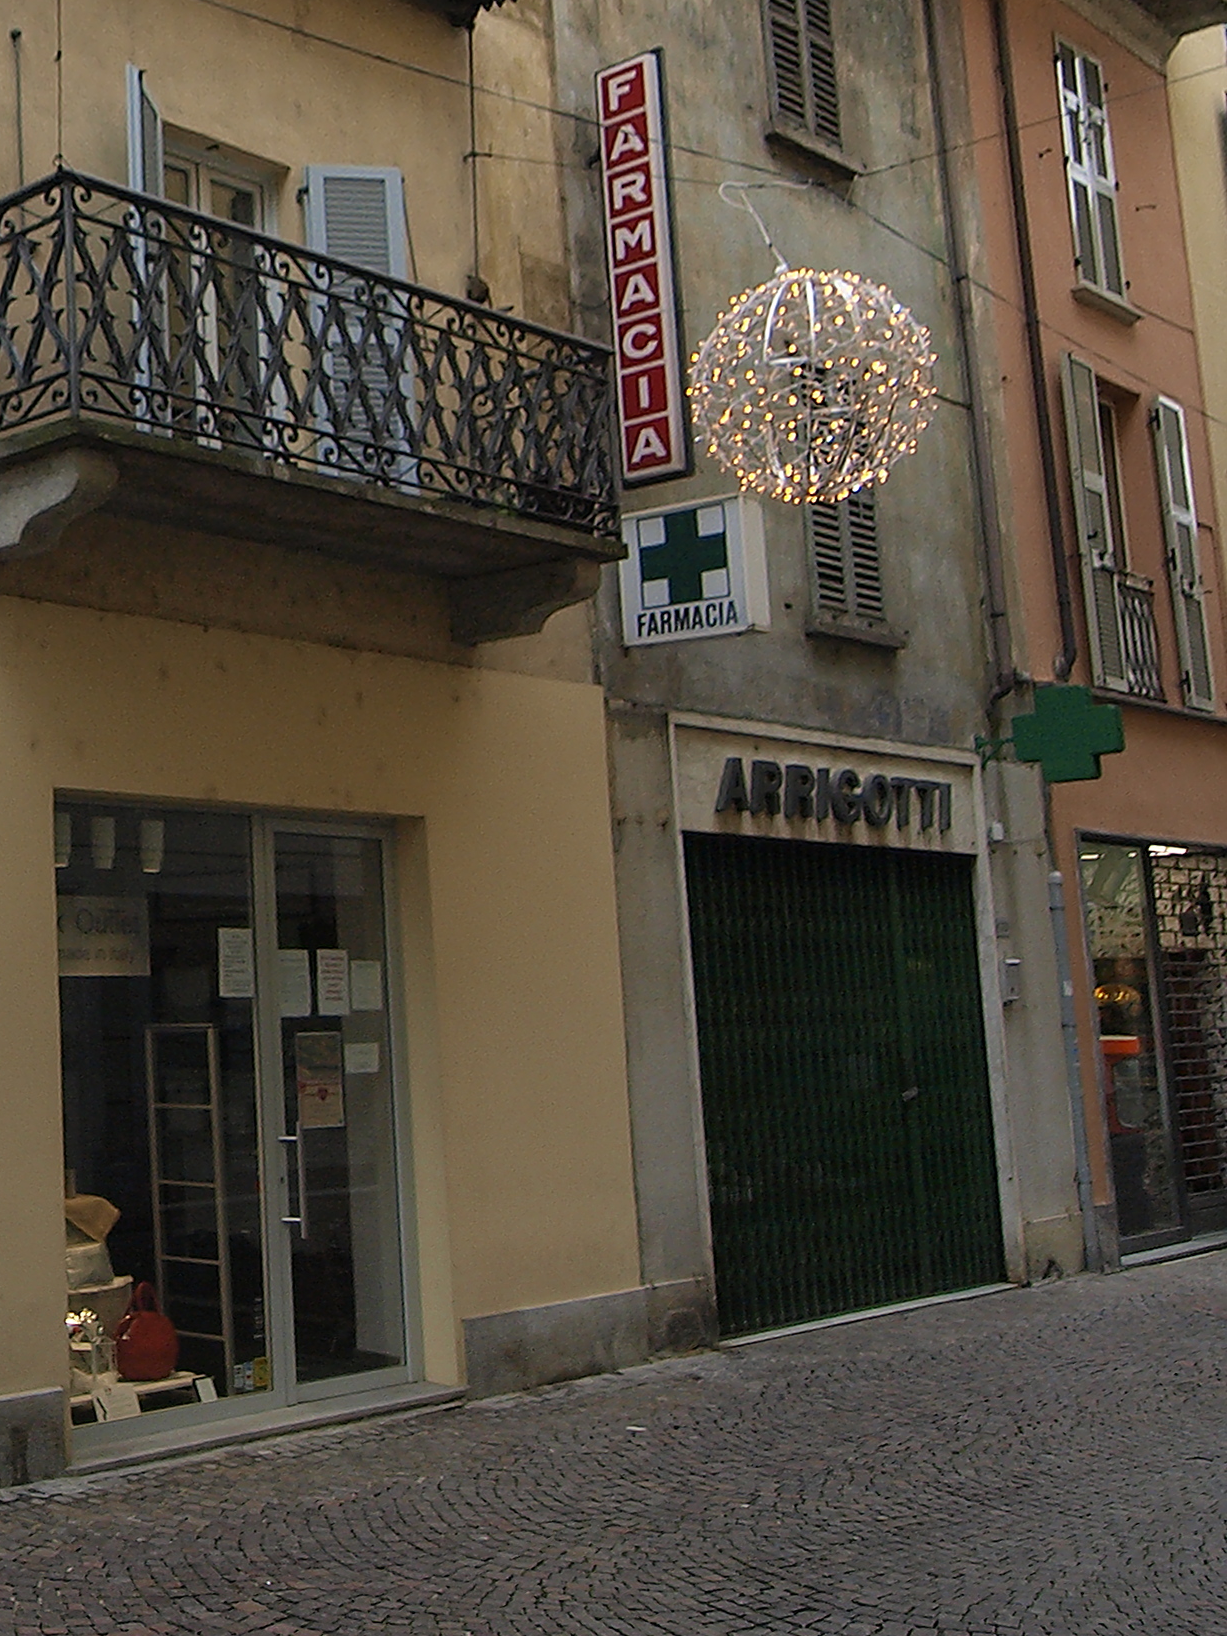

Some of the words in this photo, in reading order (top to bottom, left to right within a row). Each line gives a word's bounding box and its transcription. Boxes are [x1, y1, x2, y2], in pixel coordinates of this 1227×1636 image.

[606, 69, 667, 465] FARMACIA
[636, 600, 739, 638] FARMACIA
[714, 756, 952, 834] ARRIGOTTI
